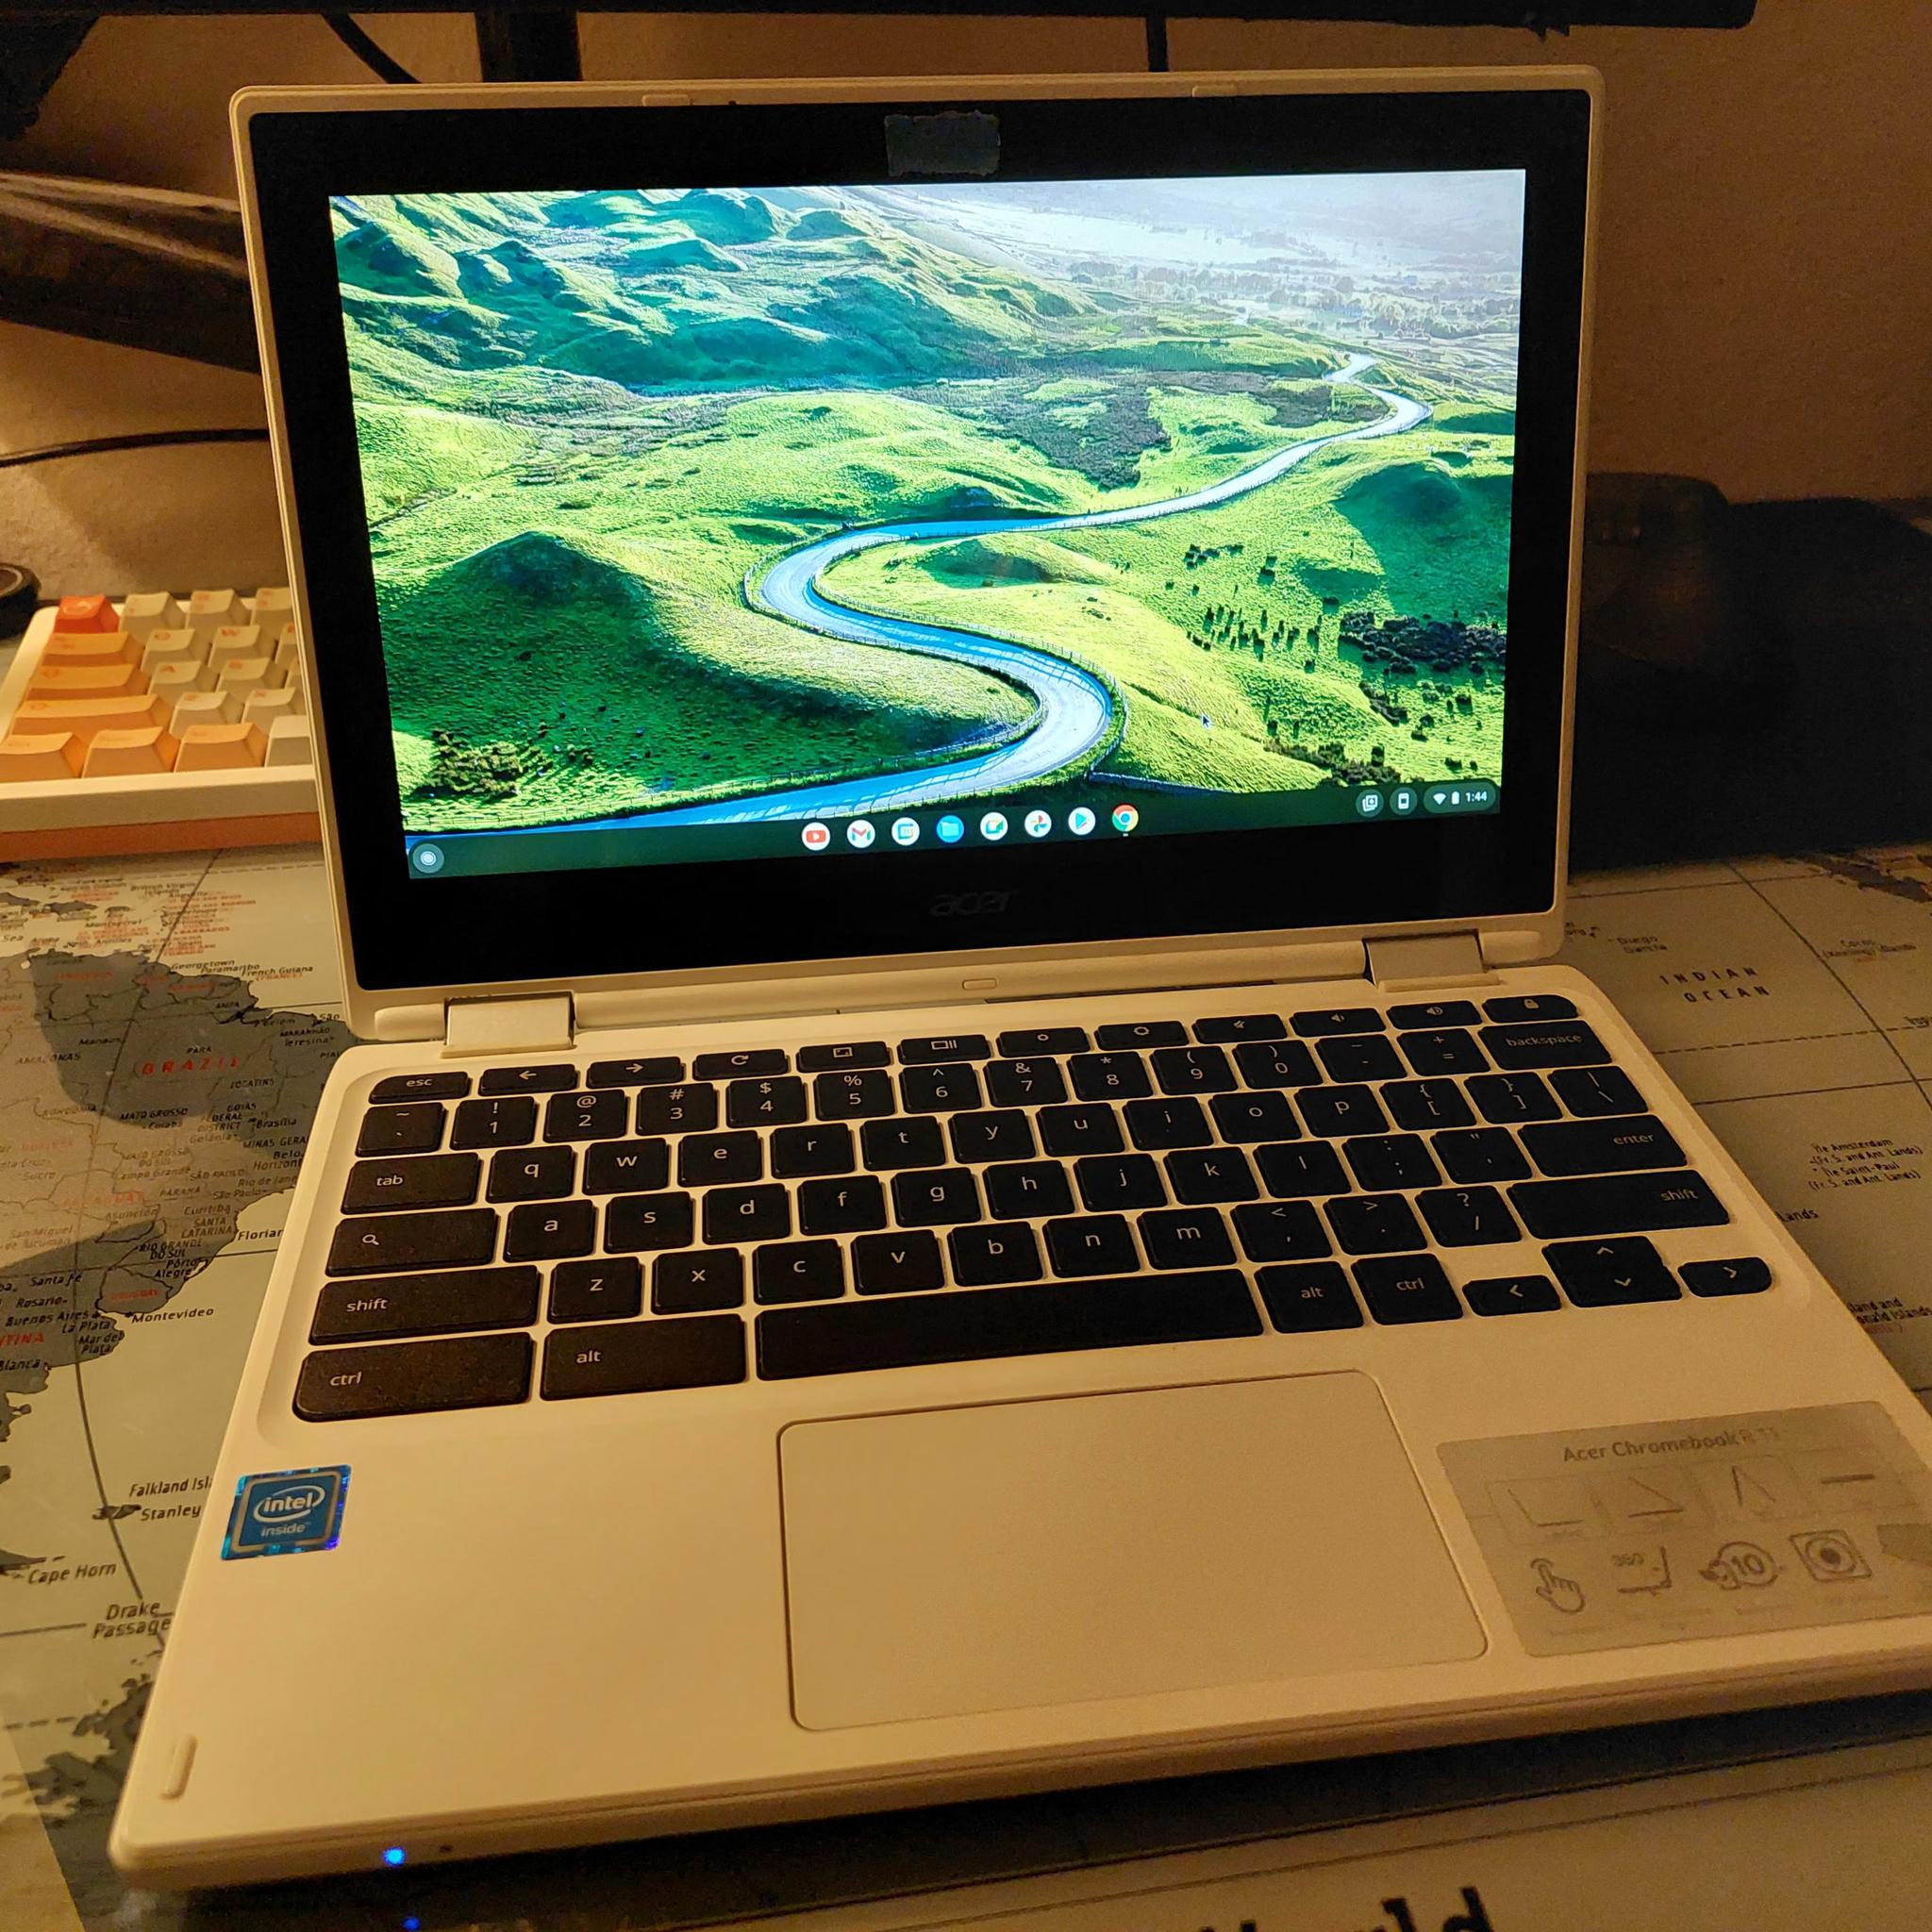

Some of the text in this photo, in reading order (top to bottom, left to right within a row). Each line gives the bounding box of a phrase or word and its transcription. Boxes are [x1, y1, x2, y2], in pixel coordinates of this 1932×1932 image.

[1465, 791, 1488, 802] 1:44
[930, 890, 1015, 917] acer
[171, 959, 235, 972] Georgetown
[1659, 966, 1758, 985] INDIAN
[1683, 985, 1771, 1004] OCEAN
[1506, 1033, 1583, 1050] backspace
[142, 1057, 241, 1075] BRAZIL
[1015, 1062, 1031, 1074] &
[1274, 1062, 1289, 1074] 0
[843, 1074, 862, 1087] %
[1106, 1074, 1120, 1086] 8
[1190, 1068, 1204, 1080] 9
[405, 1075, 433, 1090] esc
[759, 1081, 772, 1094] $
[1021, 1079, 1033, 1091] 7
[667, 1088, 685, 1102] #
[849, 1092, 861, 1105] 5
[935, 1086, 948, 1098] 6
[576, 1095, 597, 1108] @
[759, 1100, 774, 1112] 4
[1334, 1101, 1350, 1115] p
[670, 1107, 683, 1120] 3
[1164, 1109, 1172, 1124] i
[1248, 1107, 1263, 1117] o
[490, 1121, 498, 1134] 1
[578, 1114, 591, 1127] 2
[1074, 1119, 1089, 1130] u
[898, 1131, 909, 1143] t
[985, 1125, 998, 1141] y
[1613, 1134, 1654, 1145] enter
[713, 1148, 727, 1159] e
[808, 1141, 817, 1152] r
[616, 1156, 638, 1168] w
[1204, 1162, 1220, 1176] k
[1298, 1156, 1307, 1170] l
[524, 1163, 540, 1178] q
[1119, 1167, 1127, 1188] j
[376, 1174, 404, 1186] tab
[1021, 1176, 1038, 1191] h
[837, 1191, 847, 1207] f
[930, 1186, 945, 1202] g
[1457, 1192, 1470, 1208] ?
[1660, 1189, 1698, 1201] shift
[740, 1199, 755, 1215] d
[643, 1211, 657, 1224] s
[543, 1220, 558, 1232] a
[1176, 1226, 1201, 1240] m
[988, 1239, 1004, 1255] b
[1085, 1234, 1101, 1247] n
[891, 1251, 906, 1264] v
[793, 1260, 807, 1273] c
[30, 1276, 64, 1287] Santa
[691, 1269, 706, 1283] x
[590, 1278, 604, 1291] z
[1396, 1277, 1424, 1291] ctrl
[1301, 1286, 1324, 1299] alt
[346, 1298, 388, 1312] shift
[132, 1307, 214, 1324] Montevideo
[576, 1350, 601, 1364] alt
[329, 1371, 362, 1387] ctrl
[1562, 1446, 1607, 1462] Acer
[1611, 1431, 1740, 1458] Chromebook
[129, 1479, 189, 1498] Falkland
[263, 1491, 313, 1513] intel
[141, 1504, 202, 1523] Stanley
[260, 1522, 306, 1538] inside
[1730, 1554, 1766, 1576] 10
[27, 1562, 118, 1586] Cape Horn
[106, 1602, 161, 1622] Drake
[92, 1617, 172, 1640] Passage
